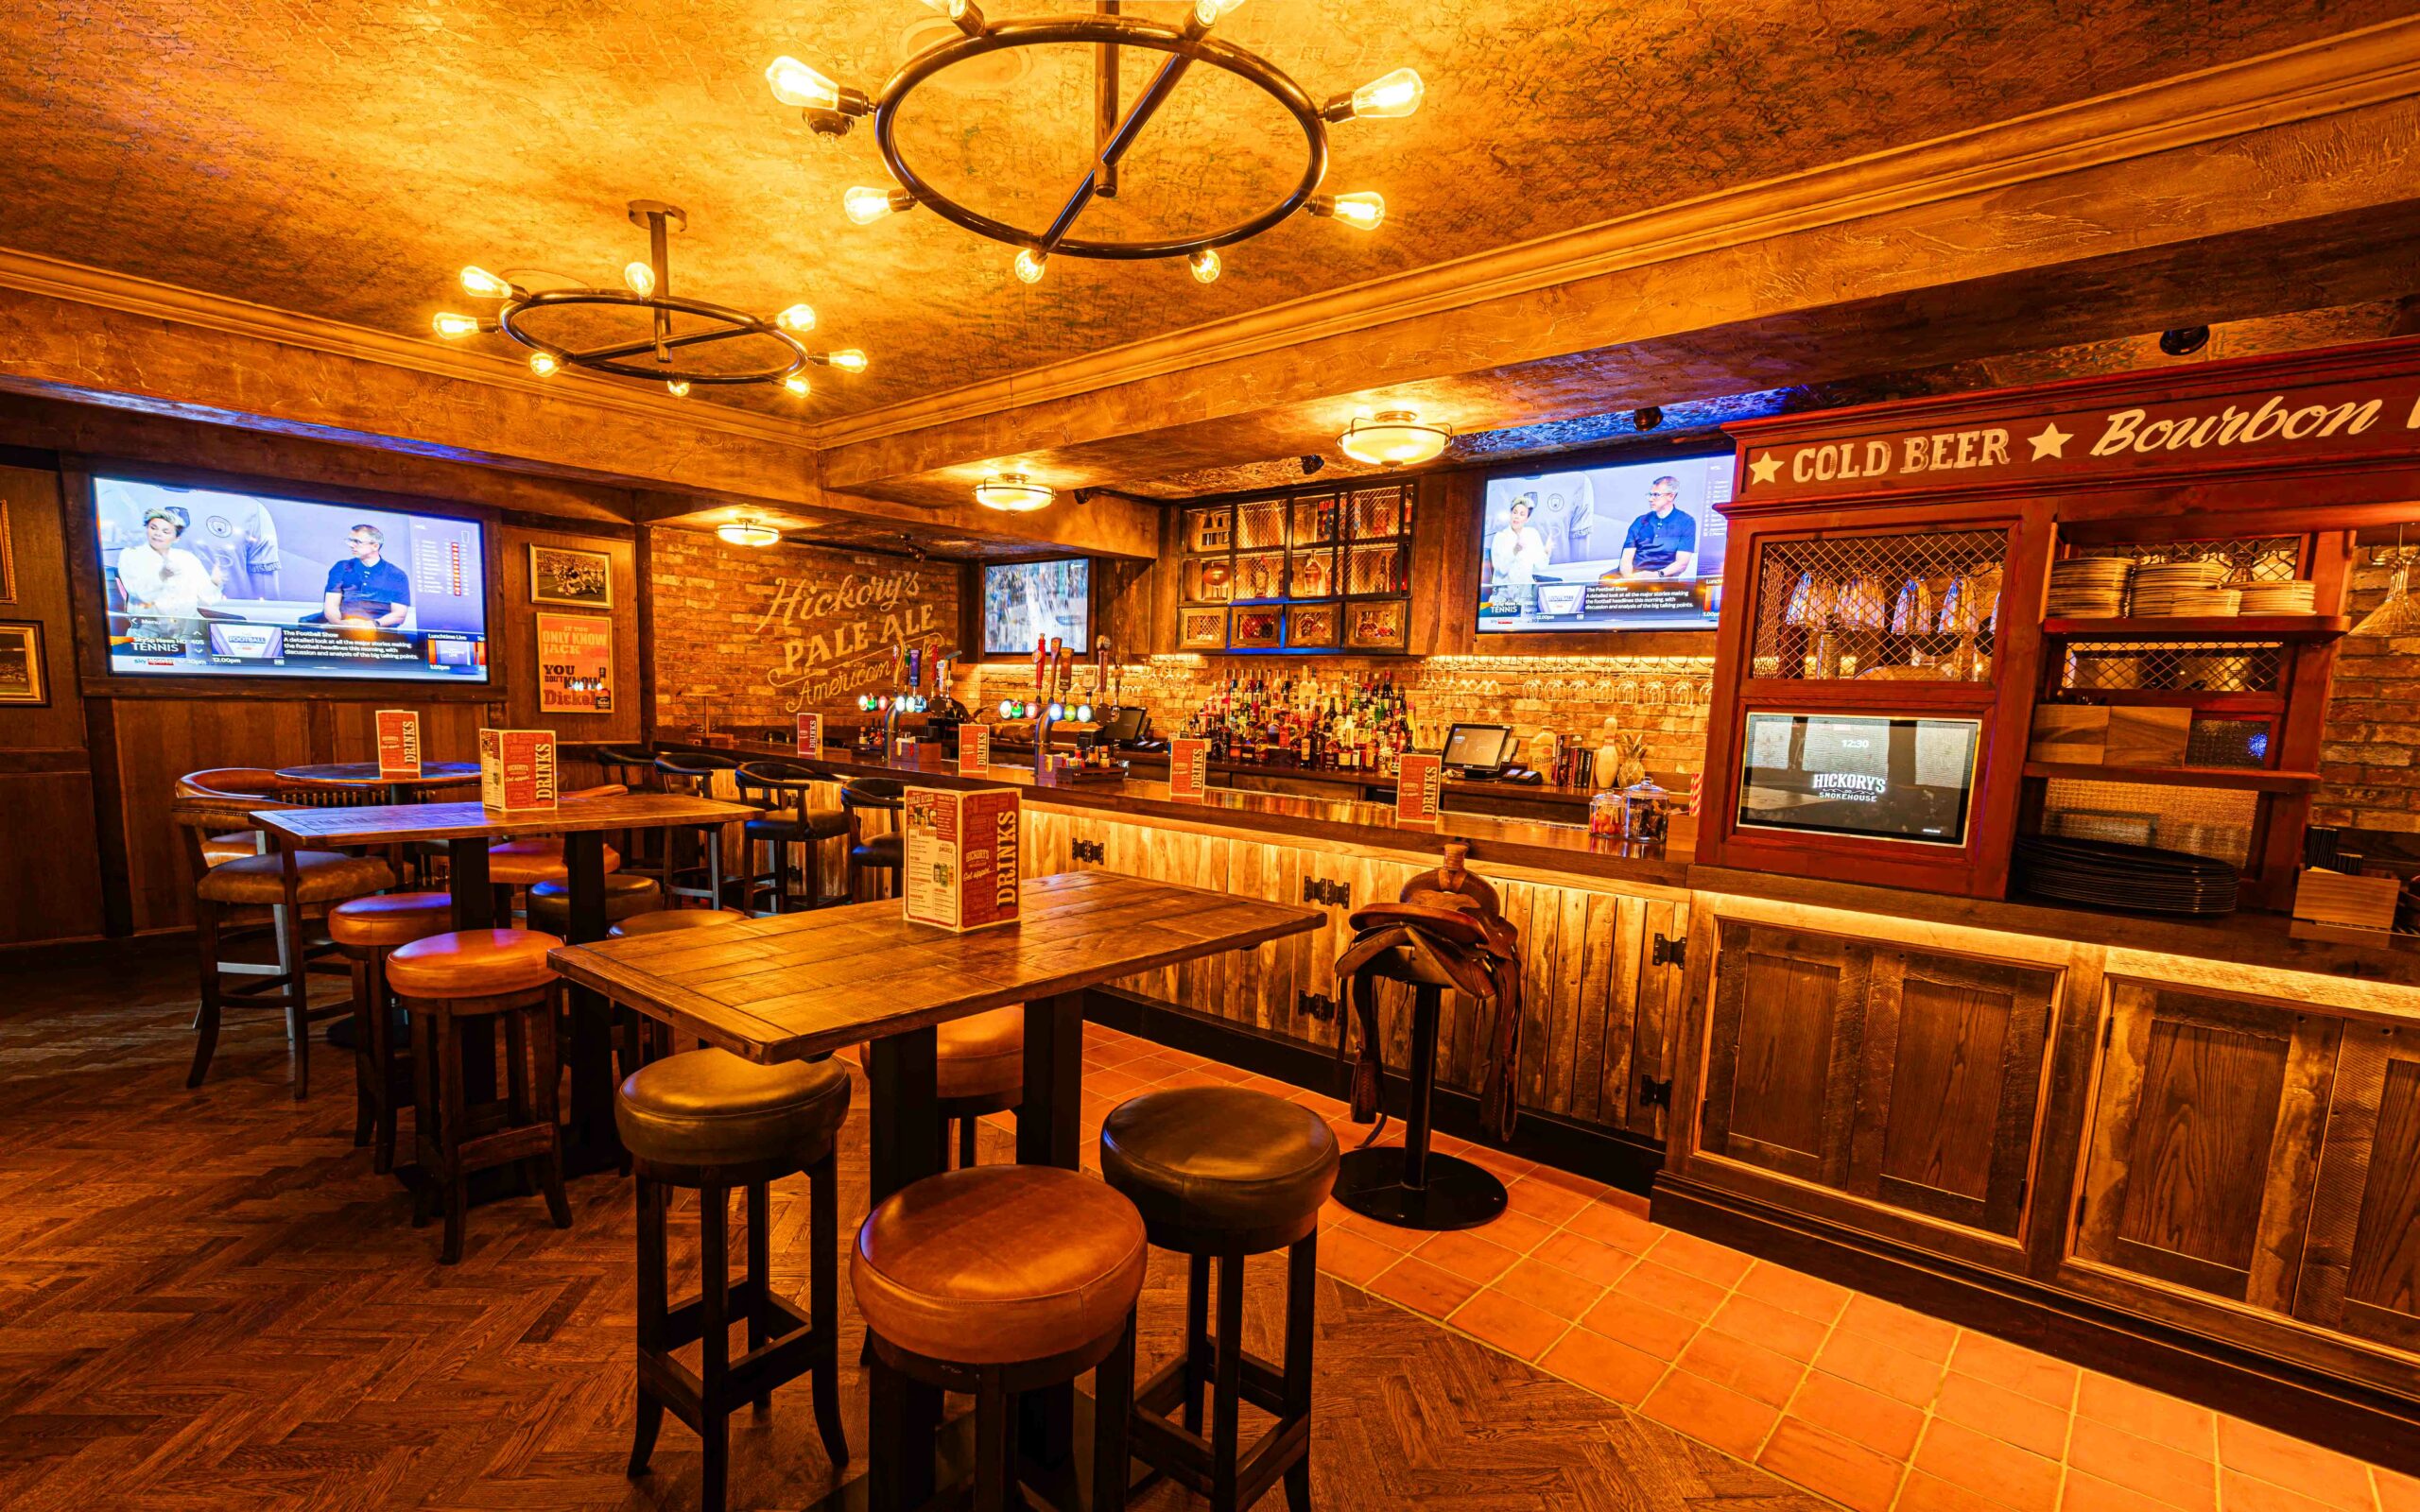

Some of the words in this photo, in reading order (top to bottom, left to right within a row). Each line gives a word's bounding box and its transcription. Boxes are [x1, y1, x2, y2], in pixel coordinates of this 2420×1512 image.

[2089, 394, 2383, 457] Bourbon
[1792, 439, 1893, 484] COLD
[1899, 427, 2011, 474] BEER
[753, 571, 920, 634] Hickory's
[131, 643, 180, 652] TENNIS
[543, 630, 570, 643] ONLY
[572, 632, 608, 646] KNOW
[544, 644, 580, 655] JACK
[784, 621, 871, 677] PALE
[879, 604, 936, 644] ALE
[543, 664, 575, 676] YOU
[785, 659, 891, 713] American
[544, 690, 596, 705] Dickel
[403, 721, 416, 763] DRINKS
[977, 731, 987, 765] DRINKS
[1841, 739, 1870, 749] 12:30
[535, 743, 553, 799] DRINKS
[1191, 747, 1202, 789] DRINKS
[1811, 772, 1887, 794] HICKORY'S
[1422, 765, 1438, 815] DRINKS
[1819, 791, 1878, 802] SMOKEHOUSE
[997, 810, 1016, 906] DRINKS
